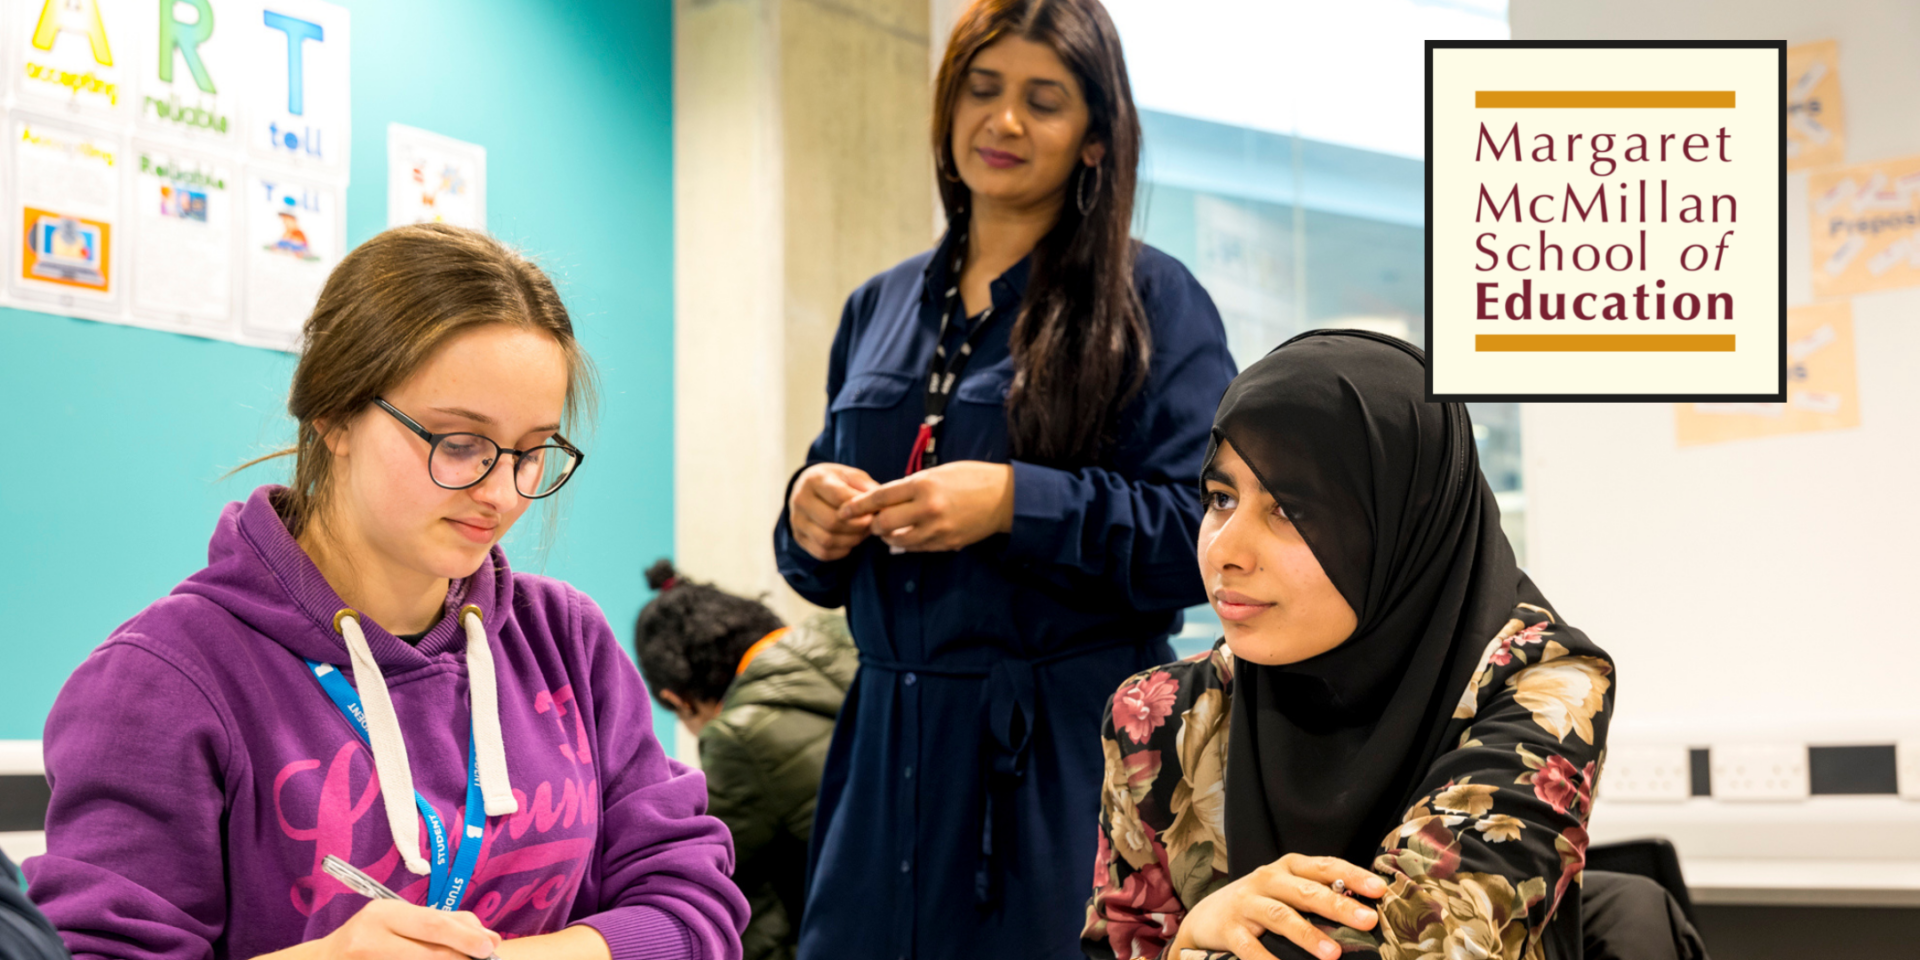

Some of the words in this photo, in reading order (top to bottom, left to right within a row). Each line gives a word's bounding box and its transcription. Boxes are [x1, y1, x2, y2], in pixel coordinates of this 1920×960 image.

[32, 0, 114, 67] A
[158, 0, 217, 94] R
[262, 9, 324, 116] T
[428, 814, 446, 865] STUDENT
[441, 877, 464, 911] STUDE
